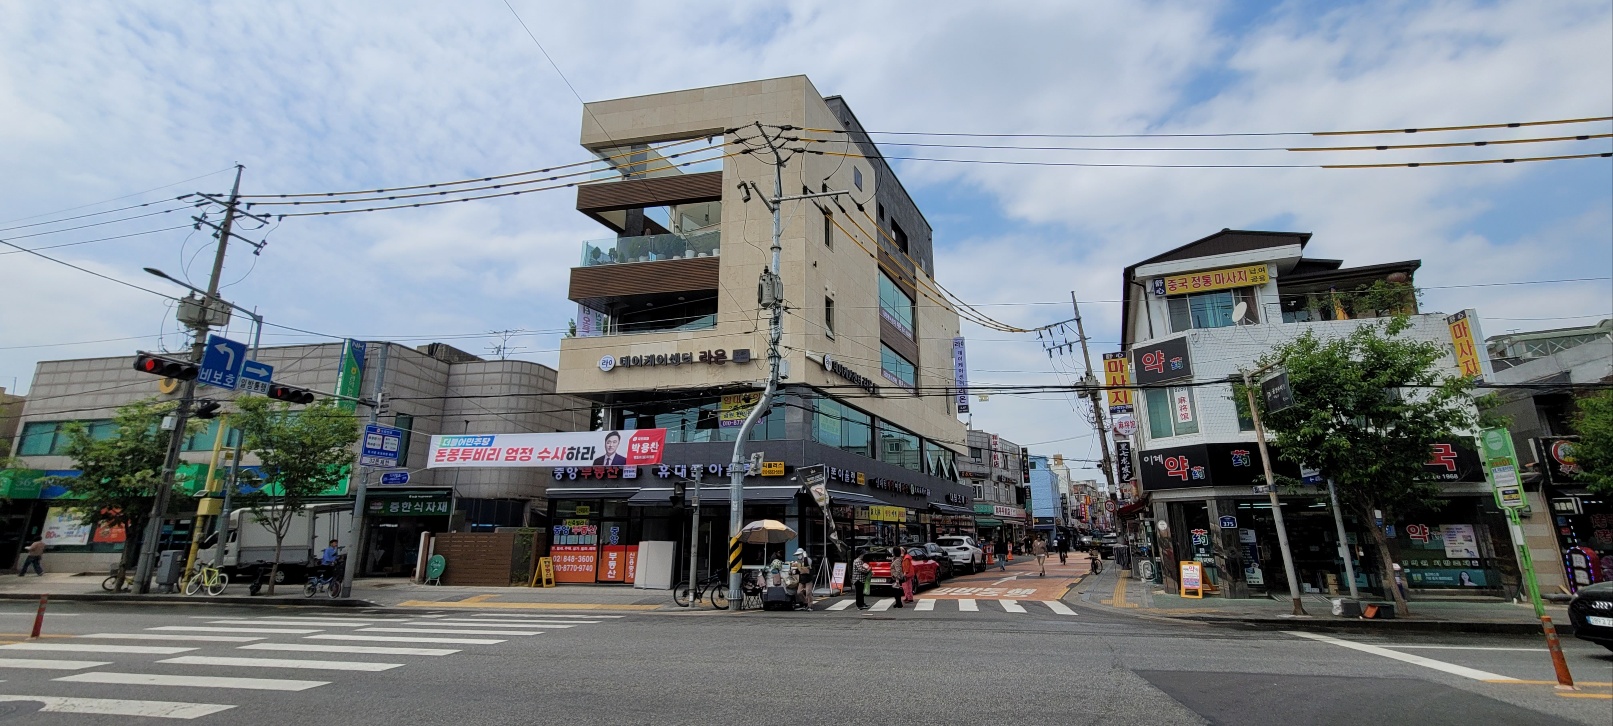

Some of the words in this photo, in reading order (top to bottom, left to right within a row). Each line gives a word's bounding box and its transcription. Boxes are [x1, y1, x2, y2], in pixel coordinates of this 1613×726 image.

[1167, 277, 1188, 292] 중국
[1191, 274, 1212, 289] 정통
[1214, 270, 1248, 285] 마사지
[619, 352, 694, 368] 데이케어센터
[699, 348, 728, 366] 라온
[1452, 321, 1479, 377] 마사지
[1142, 350, 1165, 374] 약
[199, 368, 236, 388] 비보호
[240, 378, 268, 393] 일방통행
[1107, 359, 1128, 405] 마사지
[441, 437, 491, 446] 더불어민주당
[631, 441, 660, 454] 박용찬
[435, 447, 502, 462] 돈봉투비리
[504, 447, 534, 462] 엄정
[537, 446, 596, 462] 수사하라
[1424, 444, 1458, 471] 국
[1165, 456, 1189, 481] 약
[389, 501, 448, 513] 중한식자재
[1406, 524, 1430, 544] 약
[607, 552, 618, 579] 부동산
